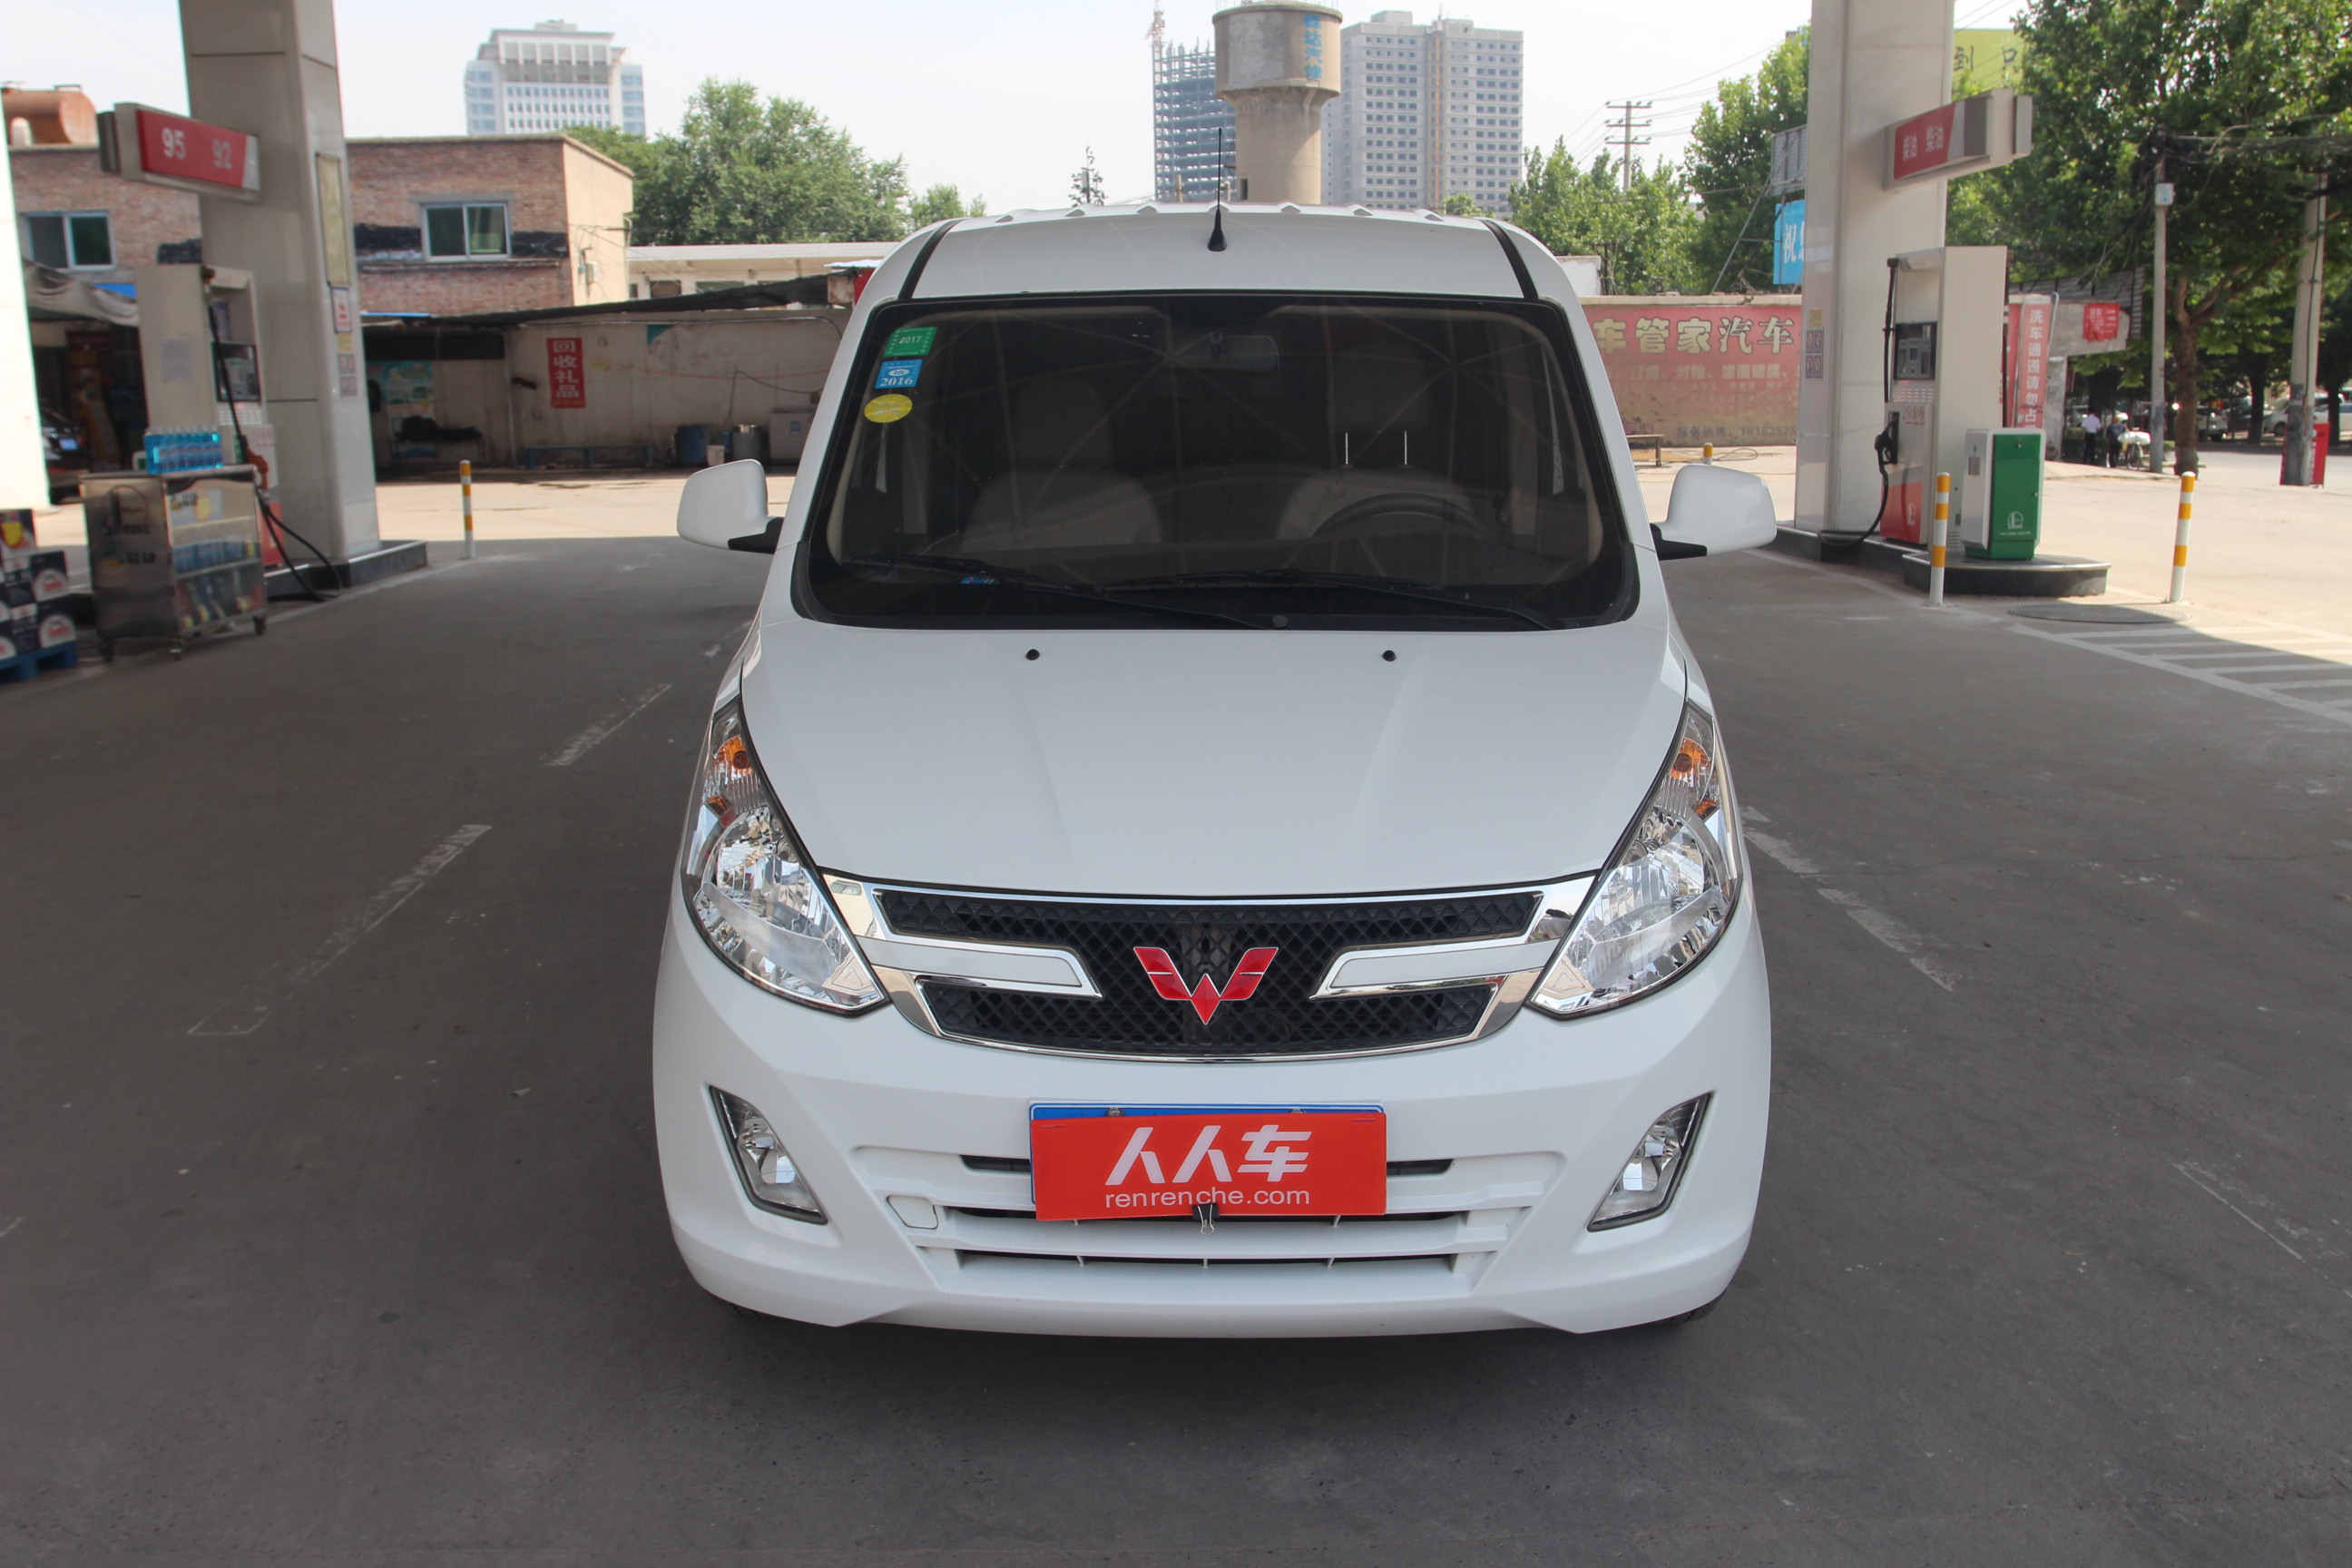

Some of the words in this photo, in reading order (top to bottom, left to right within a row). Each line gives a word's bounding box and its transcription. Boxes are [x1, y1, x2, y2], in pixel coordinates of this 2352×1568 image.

[162, 127, 186, 160] 95
[211, 138, 233, 170] 92
[898, 335, 923, 344] 2017
[1592, 316, 1794, 354] 车管家汽车
[553, 340, 579, 397] 回收礼品
[879, 377, 914, 387] 2016
[1104, 1124, 1312, 1186] 人人车
[1105, 1187, 1309, 1208] renrenche.com
